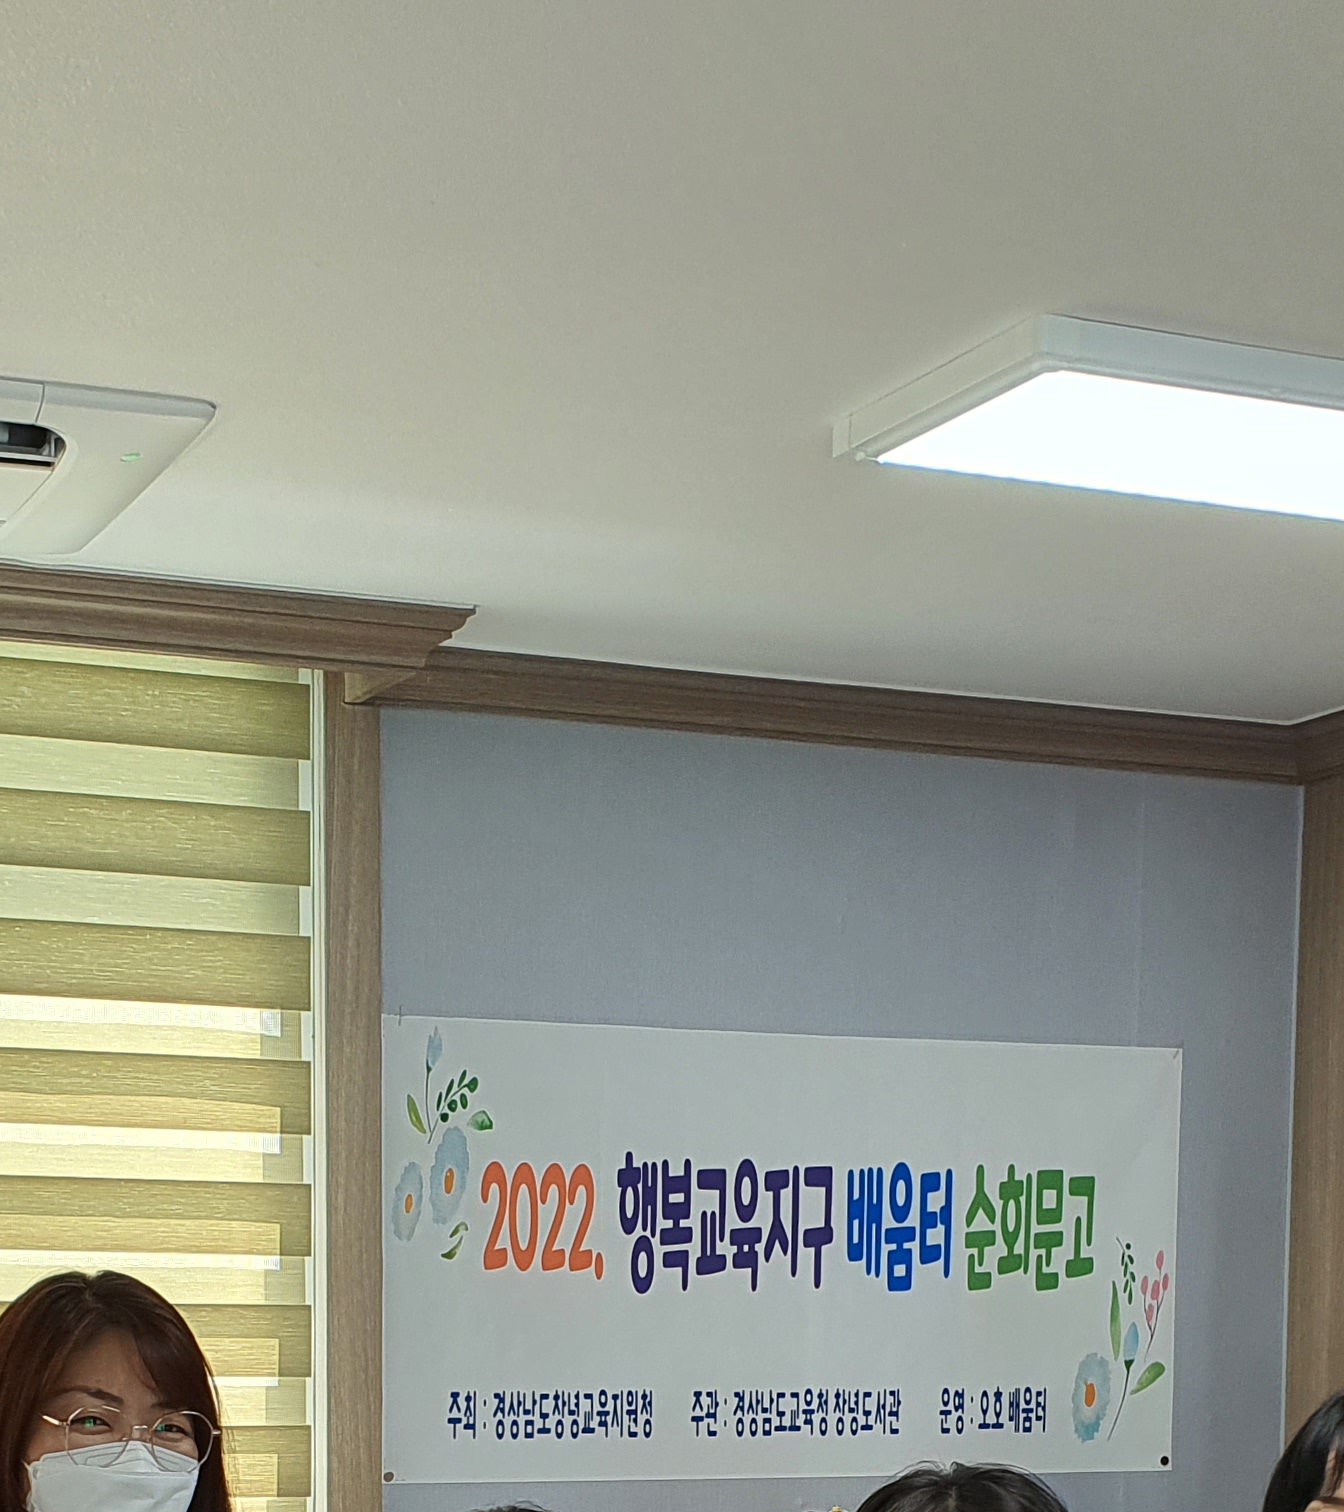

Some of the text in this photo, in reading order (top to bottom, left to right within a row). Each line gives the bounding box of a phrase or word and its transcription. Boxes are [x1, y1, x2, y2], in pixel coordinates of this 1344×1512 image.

[481, 1151, 1095, 1294] 2022. 행복교육지구 배움터 순회문고
[447, 1390, 476, 1440] 주최
[493, 1388, 655, 1441] 경상남도창녕교육지원청
[691, 1389, 719, 1440] 주관
[730, 1388, 829, 1441] 경상남도교육청
[833, 1385, 901, 1440] 창녕도서관
[939, 1388, 965, 1435] 운영
[1008, 1387, 1047, 1433] 배움터
